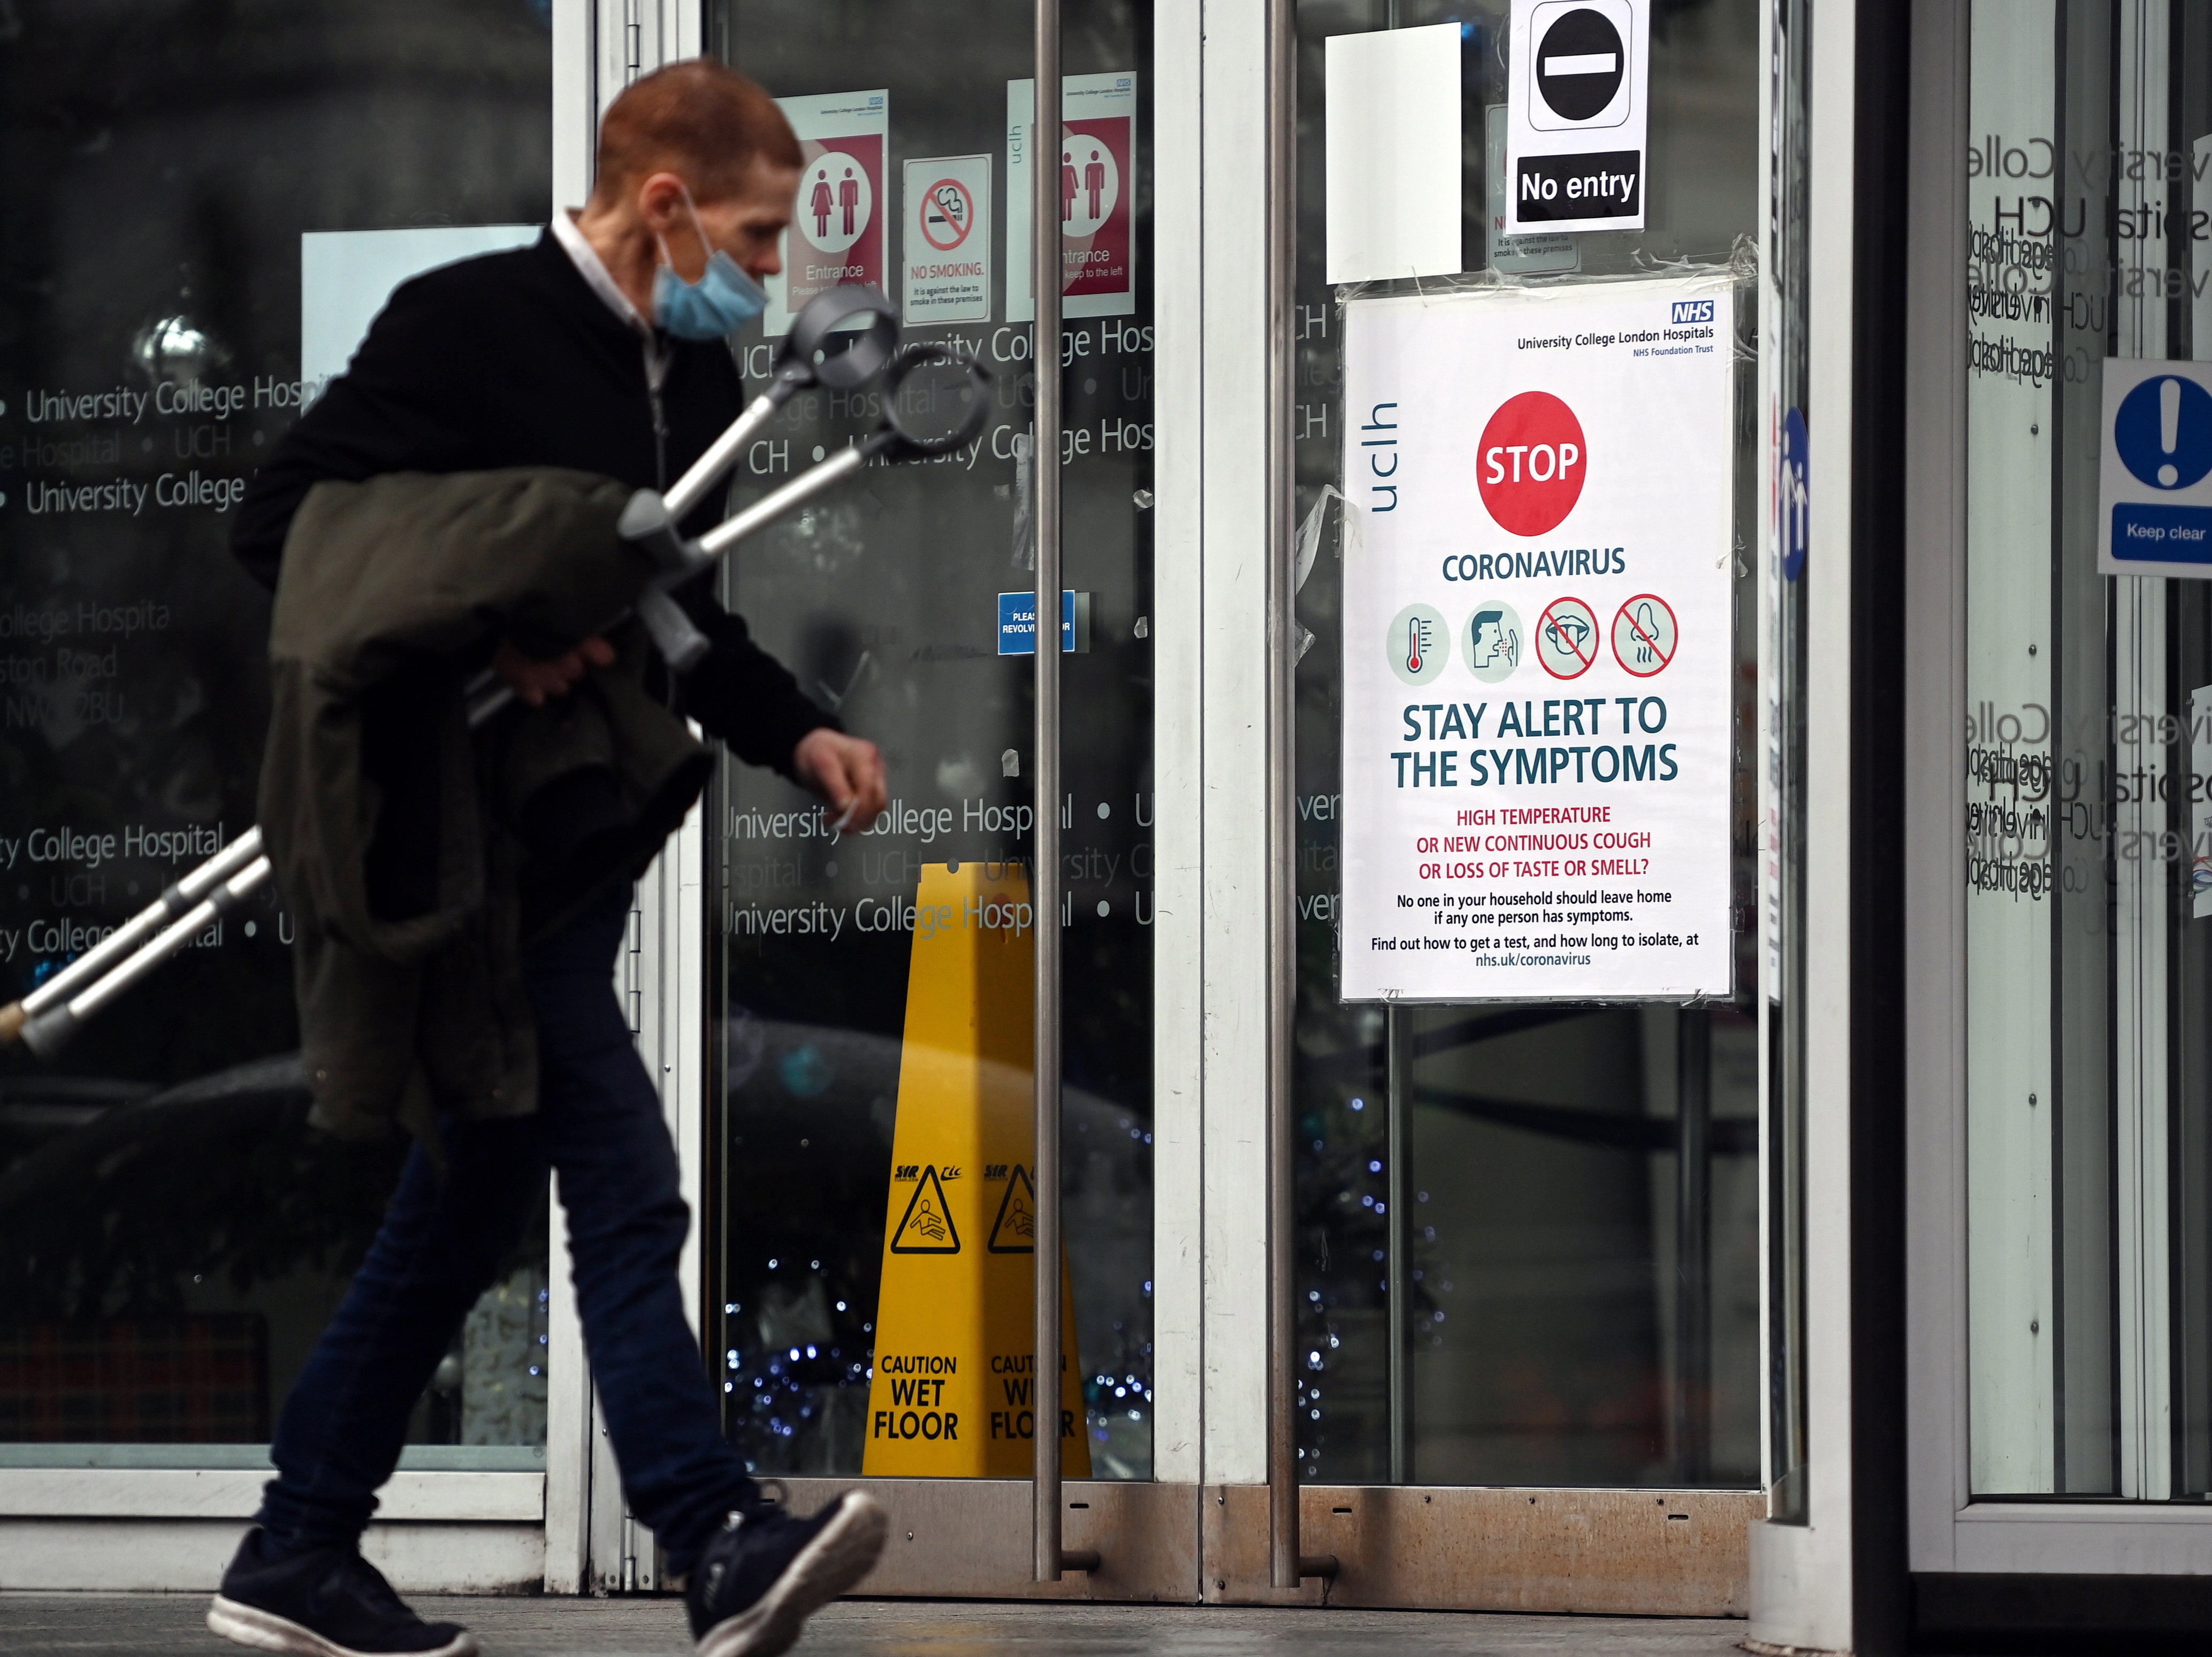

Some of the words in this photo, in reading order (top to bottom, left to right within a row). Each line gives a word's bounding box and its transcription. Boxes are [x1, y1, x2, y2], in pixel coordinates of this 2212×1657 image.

[1522, 172, 1558, 201] No
[1566, 171, 1636, 203] entry
[1494, 216, 1506, 230] N
[1063, 249, 1109, 264] ntrance
[1543, 244, 1573, 256] premises
[806, 264, 864, 280] Entrance
[911, 265, 927, 279] NO
[930, 262, 984, 279] SMOKING.
[1065, 269, 1084, 280] keep
[1086, 268, 1094, 277] to
[1096, 267, 1108, 277] the
[1110, 265, 1123, 276] left
[1674, 302, 1713, 323] NHS
[1518, 335, 1572, 350] University
[1575, 332, 1615, 347] College
[1619, 330, 1660, 343] London
[1664, 325, 1714, 343] Hospitals
[1633, 348, 1649, 357] NHS
[1651, 346, 1693, 356] Foundation
[1695, 345, 1713, 353] Trust
[26, 385, 148, 425] University
[155, 377, 245, 420] College
[1361, 402, 1398, 513] uclh
[1486, 443, 1578, 484] STOP
[26, 477, 148, 517] University
[155, 469, 245, 513] College
[2127, 523, 2165, 541] Keep
[2170, 526, 2206, 540] clear
[1443, 547, 1626, 582] CORONAVIRUS
[1404, 702, 1488, 742] STAY
[1497, 698, 1606, 738] ALERT
[1615, 696, 1667, 734] TO
[1390, 750, 1458, 788] THE
[1470, 743, 1678, 786] SYMPTOMS
[1457, 809, 1495, 826] HIGH
[1500, 806, 1611, 825] TEMPERATURE
[27, 825, 117, 869] College
[124, 820, 224, 865] Hospital
[1417, 837, 1439, 853] OR
[1444, 836, 1481, 853] NEW
[1485, 833, 1589, 852] CONTINUOUS
[1593, 832, 1651, 849] COUGH
[1419, 863, 1441, 879] OR
[1446, 862, 1484, 879] LOSS
[1489, 862, 1509, 878] OF
[1513, 861, 1559, 877] TASTE
[1564, 860, 1586, 876] OR
[1591, 858, 1649, 876] SMELL?
[1398, 894, 1414, 908] No
[1417, 896, 1439, 908] one
[1444, 893, 1454, 907] in
[1458, 896, 1486, 910] your
[1490, 891, 1553, 906] household
[1556, 890, 1597, 904] should
[1601, 890, 1633, 903] leave
[1637, 889, 1672, 903] home
[855, 895, 953, 941] College
[1435, 910, 1443, 925] if
[1446, 914, 1468, 928] any
[1471, 914, 1494, 924] one
[1498, 913, 1539, 927] person
[1543, 909, 1563, 923] has
[1567, 909, 1633, 926] symptoms.
[1372, 936, 1396, 951] Find
[1400, 938, 1421, 950] out
[1424, 936, 1451, 949] how
[1453, 937, 1467, 949] to
[1470, 937, 1490, 955] get
[1493, 938, 1500, 949] a
[1504, 936, 1530, 952] test,
[1534, 933, 1557, 948] and
[1560, 933, 1588, 948] how
[1591, 933, 1618, 951] long
[1621, 934, 1635, 947] to
[1639, 932, 1682, 947] isolate,
[1686, 933, 1699, 946] at
[1475, 953, 1591, 967] nhs.uk/coronavirus
[881, 1355, 957, 1374] CAUTION
[891, 1378, 945, 1407] WET
[874, 1410, 958, 1440] FLOOR
